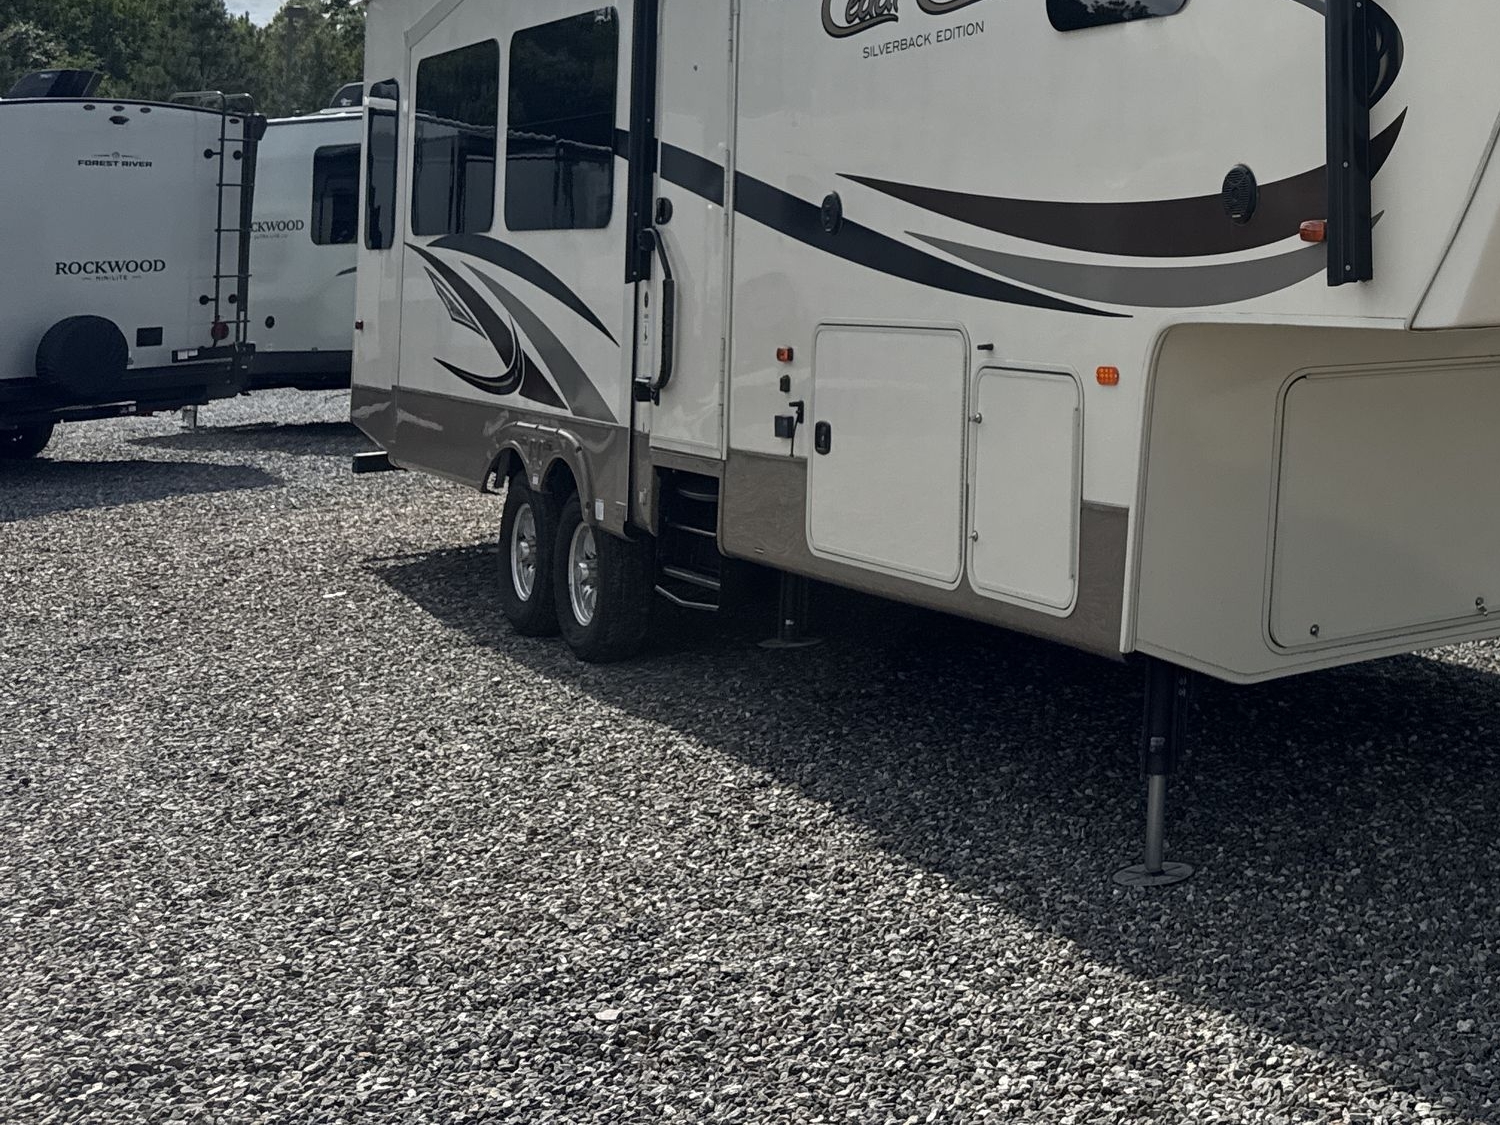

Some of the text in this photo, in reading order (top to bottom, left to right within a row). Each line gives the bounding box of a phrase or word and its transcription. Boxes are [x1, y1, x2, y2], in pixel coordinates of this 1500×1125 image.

[862, 20, 985, 59] SILVERBACK EDITION
[78, 159, 119, 167] FOREST
[250, 219, 305, 233] CKWOOD
[55, 259, 166, 275] ROCKWOOD
